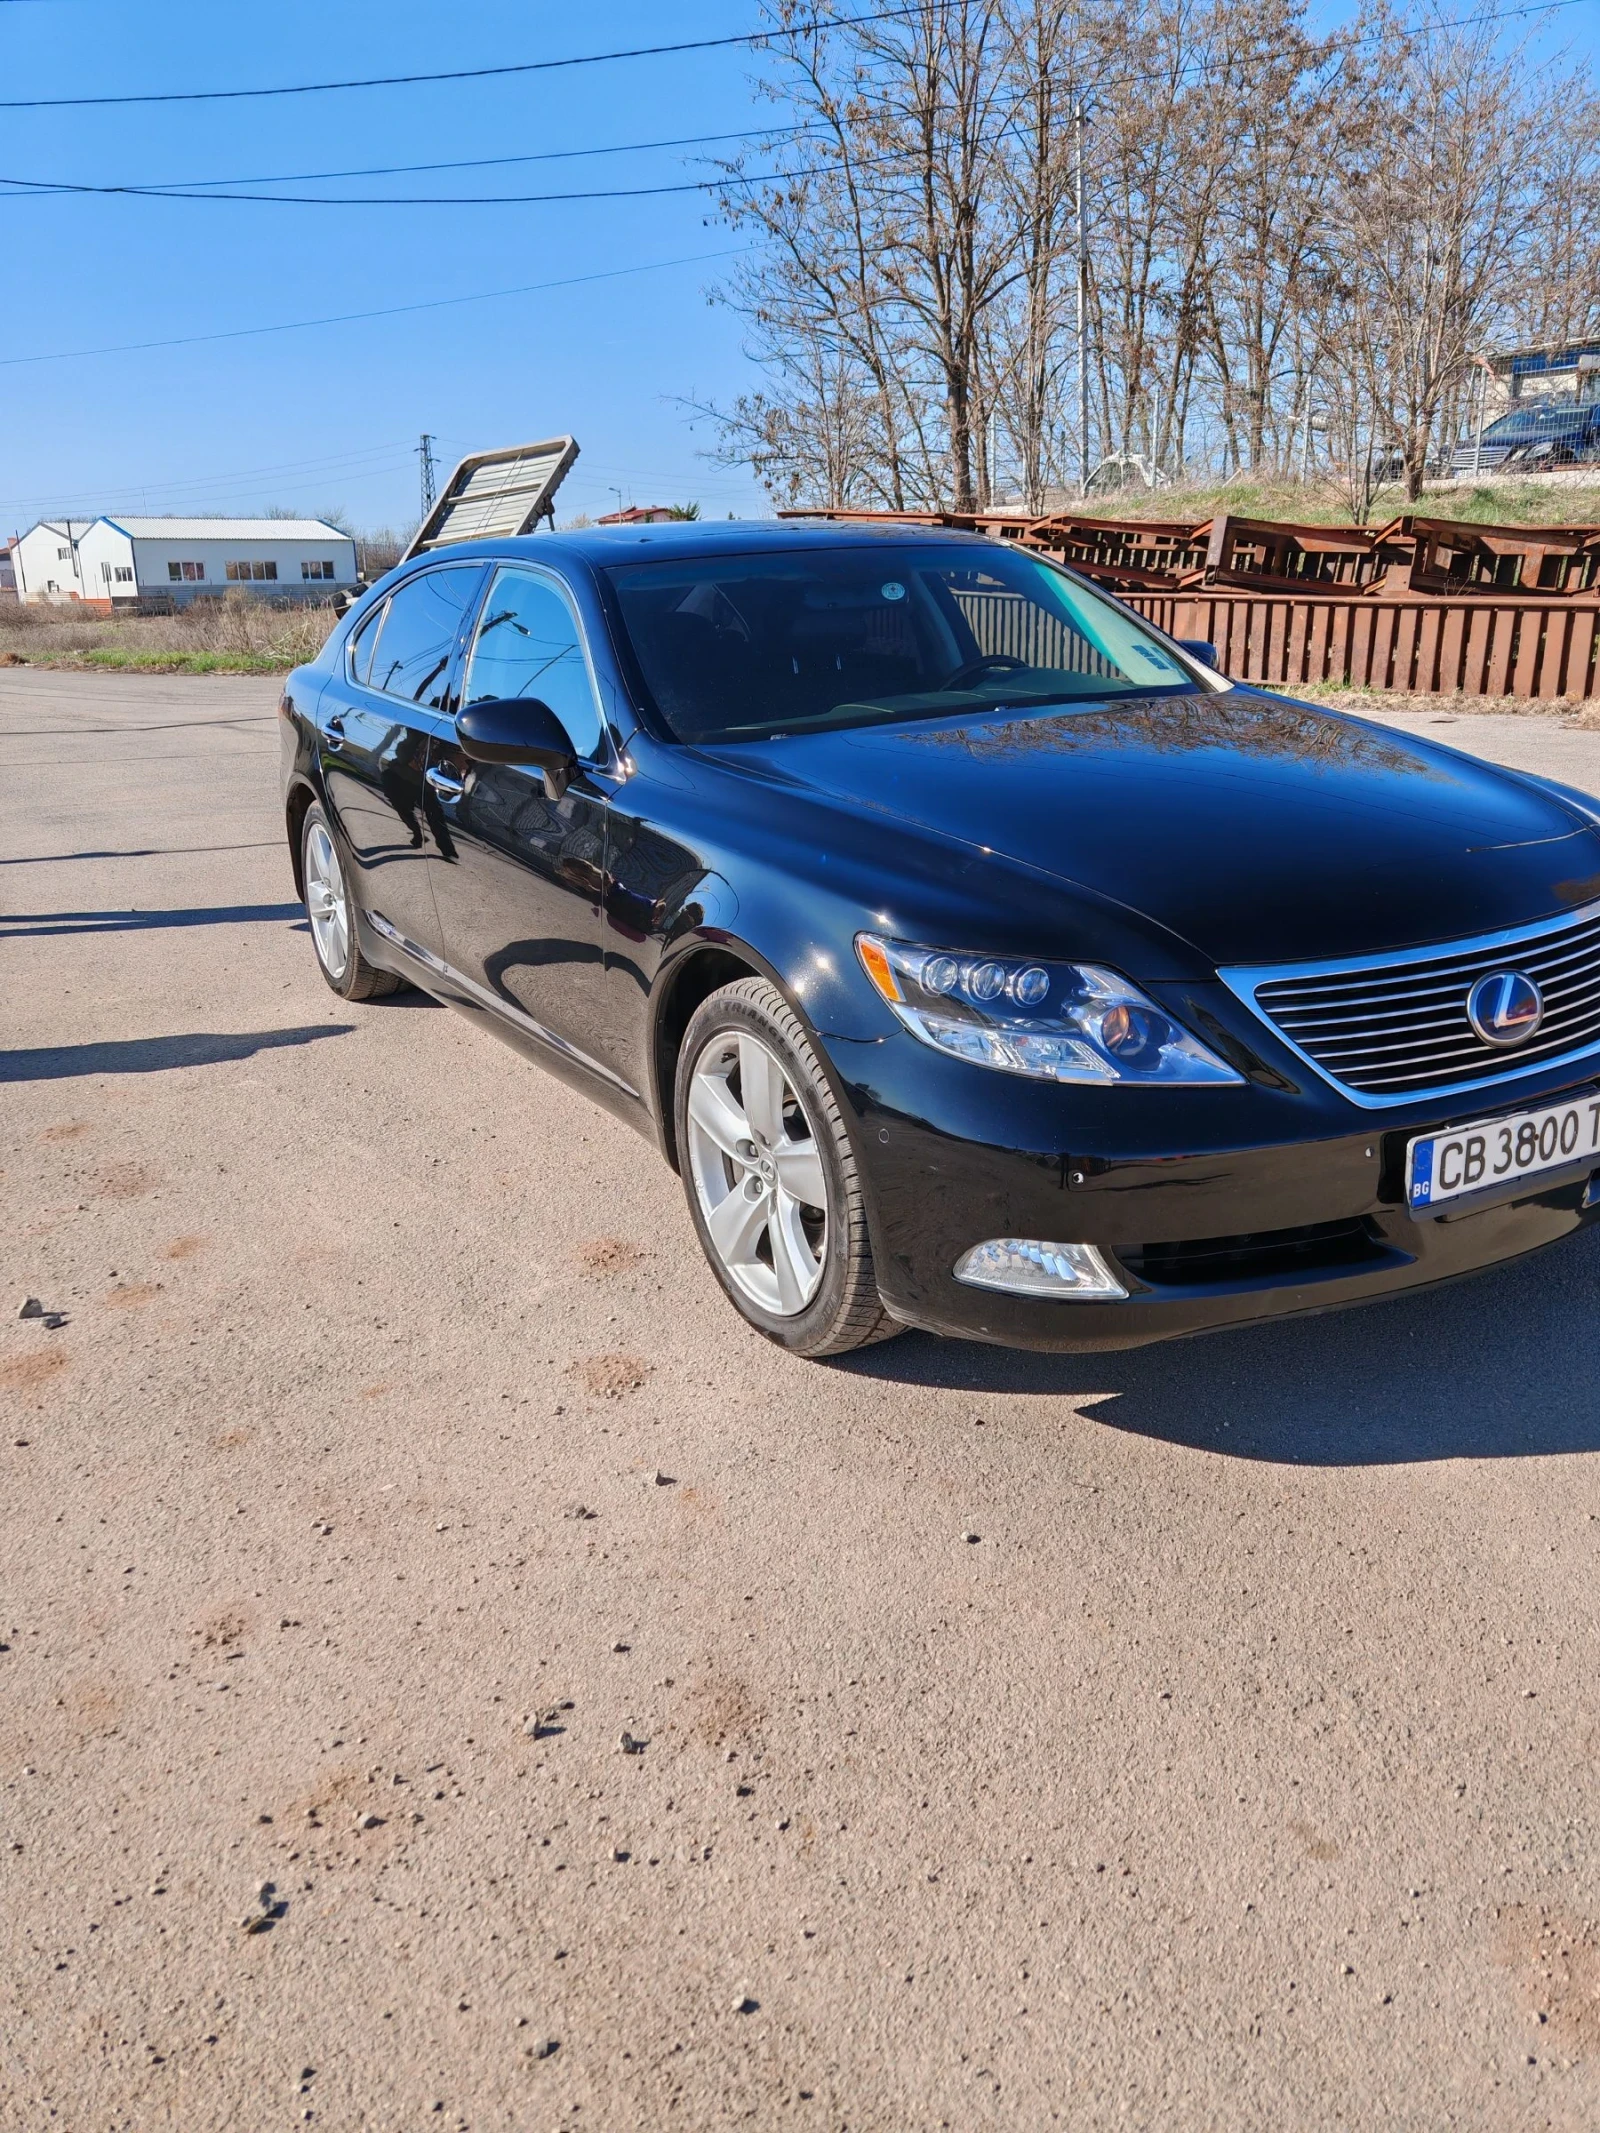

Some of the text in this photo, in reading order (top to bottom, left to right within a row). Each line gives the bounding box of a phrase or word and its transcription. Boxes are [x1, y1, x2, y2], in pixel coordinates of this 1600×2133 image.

[723, 1001, 799, 1070] TRIANGLE
[1439, 1136, 1486, 1190] CB
[1493, 1109, 1579, 1174] 3800
[1413, 1180, 1430, 1198] BG
